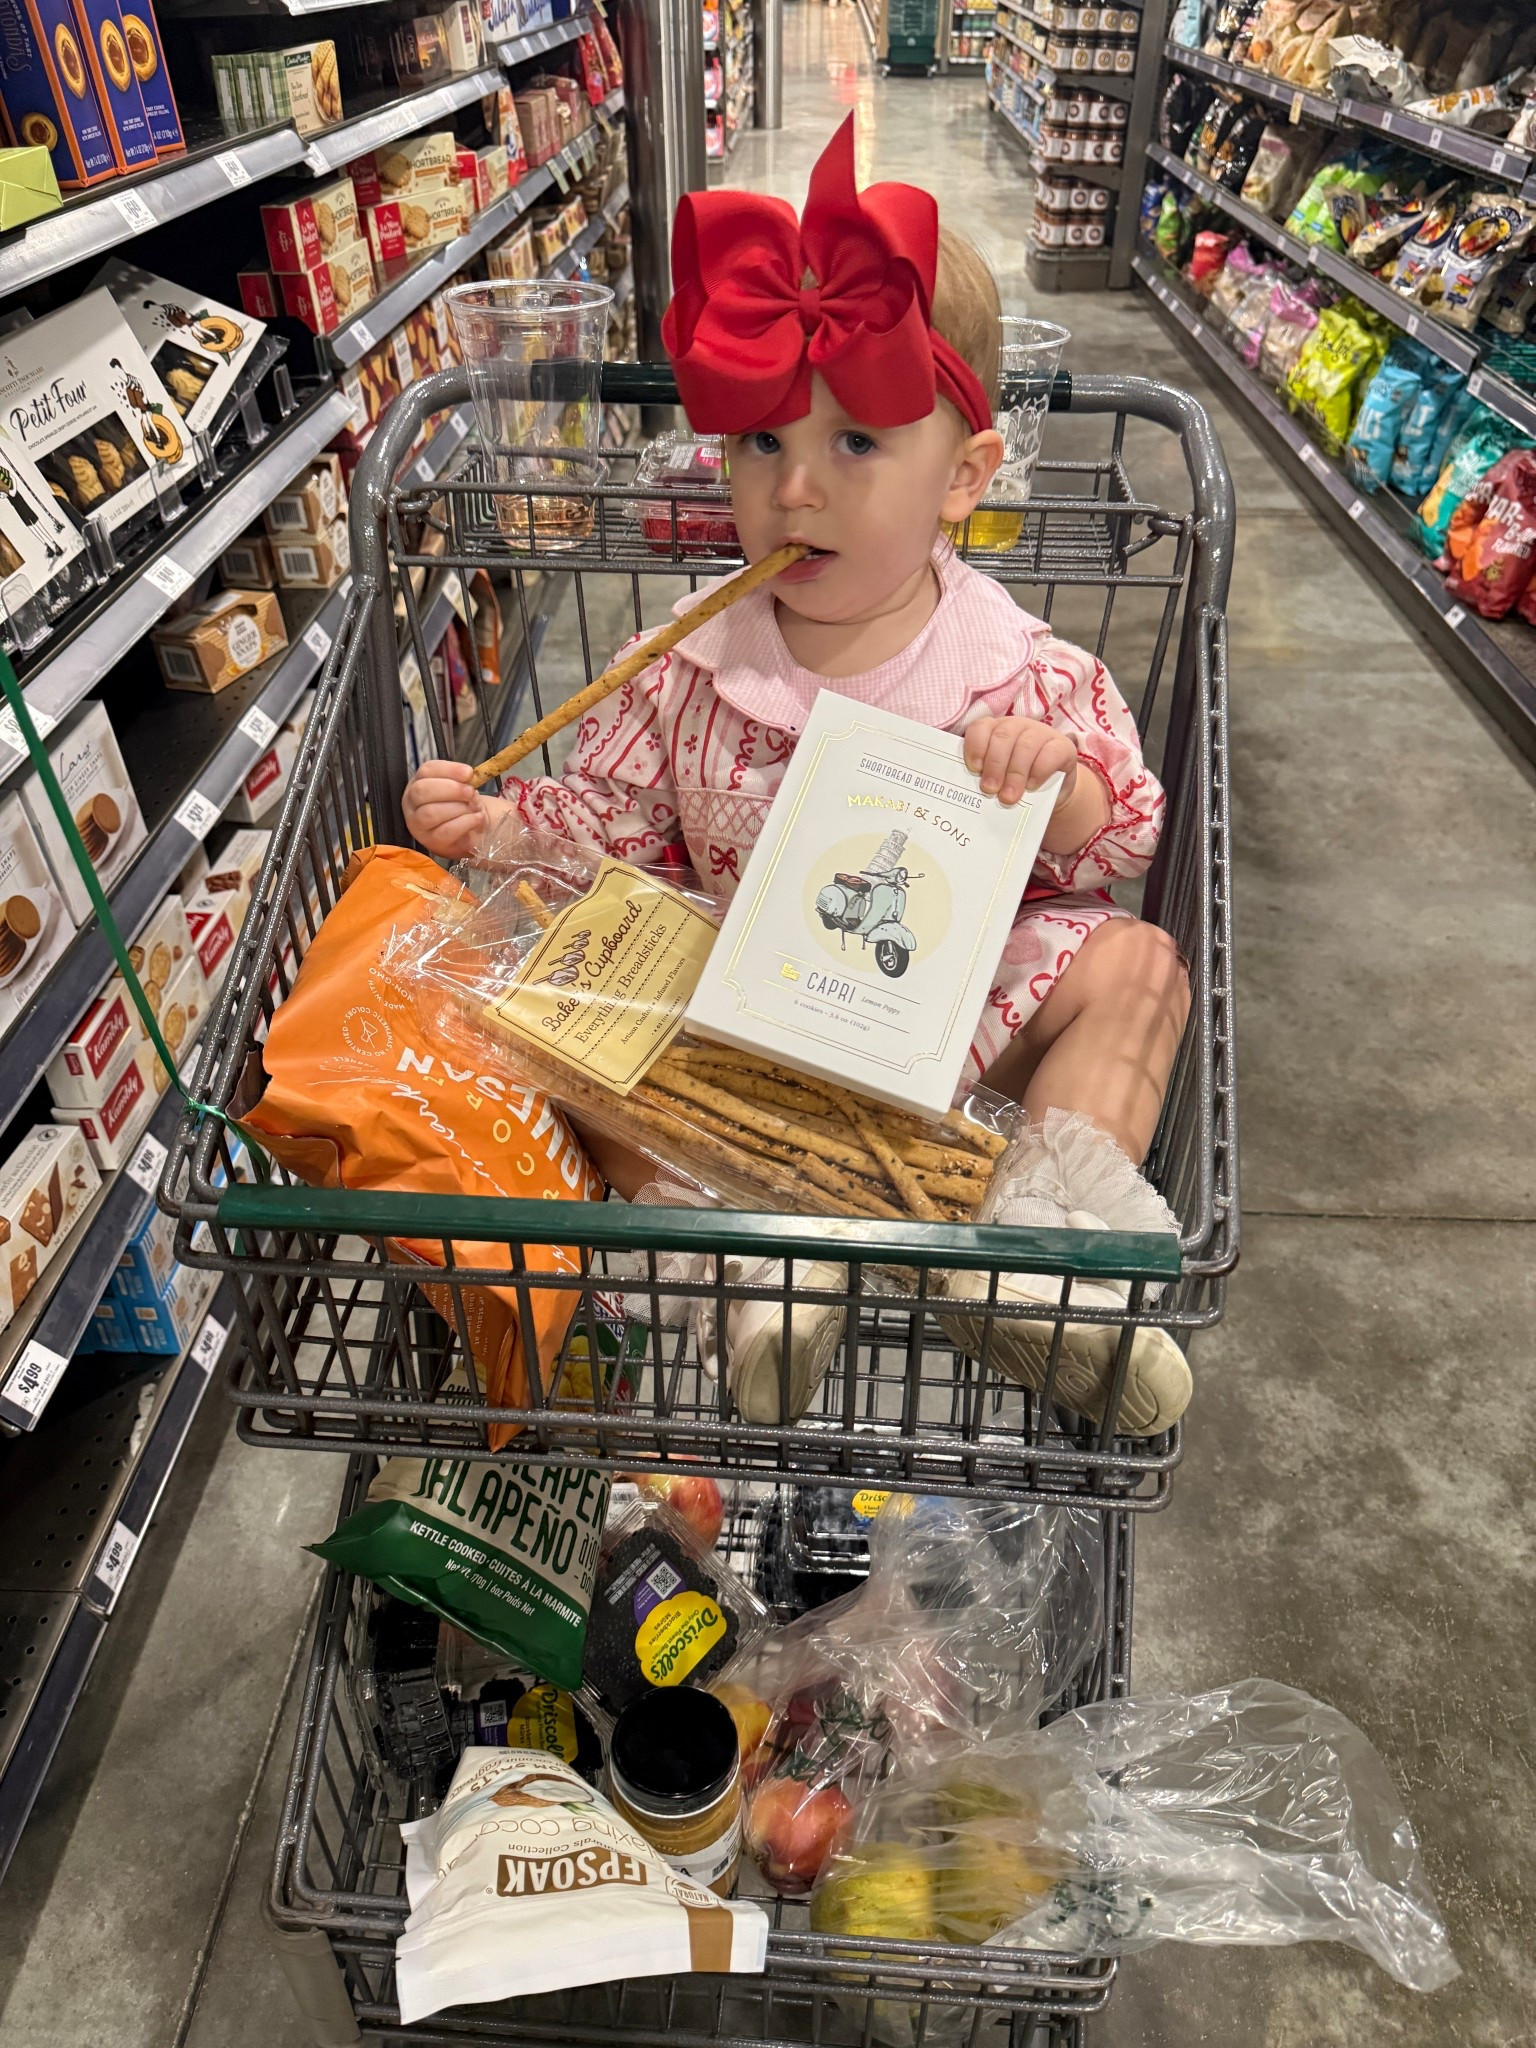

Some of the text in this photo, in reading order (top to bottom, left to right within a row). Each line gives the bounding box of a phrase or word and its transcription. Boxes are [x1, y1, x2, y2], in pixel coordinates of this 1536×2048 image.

[10, 393, 57, 442] Petit
[50, 376, 88, 414] Four
[860, 757, 982, 809] SHORTBREAD BUTTER COOKIES
[847, 793, 971, 847] MAKABI & SONS
[368, 966, 415, 1004] NON-GMO
[368, 979, 382, 1002] WITH
[541, 899, 644, 1033] Bake's Cupboard
[573, 923, 668, 1045] Everything Breadsticks
[622, 957, 687, 1046] Artisan Crafted Infused Flavors
[799, 1001, 824, 1015] cookies
[806, 972, 901, 1016] CAPRI Lemon Poppy
[93, 1011, 124, 1066] Kambly
[342, 1026, 373, 1057] CERTIFIED
[345, 1006, 394, 1049] SYNTHETIC COLORS
[108, 1074, 139, 1128] Kambly
[409, 1458, 578, 1575] JALAPEÑO
[409, 1520, 582, 1628] KETTLE COOKED CUITES À LA MARMITE
[445, 1558, 461, 1571] Net
[489, 1583, 503, 1598] 6oz
[501, 1591, 522, 1610] Poids
[521, 1602, 536, 1617] Net
[648, 1610, 682, 1646] Blackberries
[650, 1607, 719, 1681] Driscoll's
[653, 1612, 672, 1631] Mûres
[508, 1838, 617, 1854] aturals Collection
[503, 1851, 645, 1894] EPSOAK
[674, 1887, 710, 1903] NATURAL
